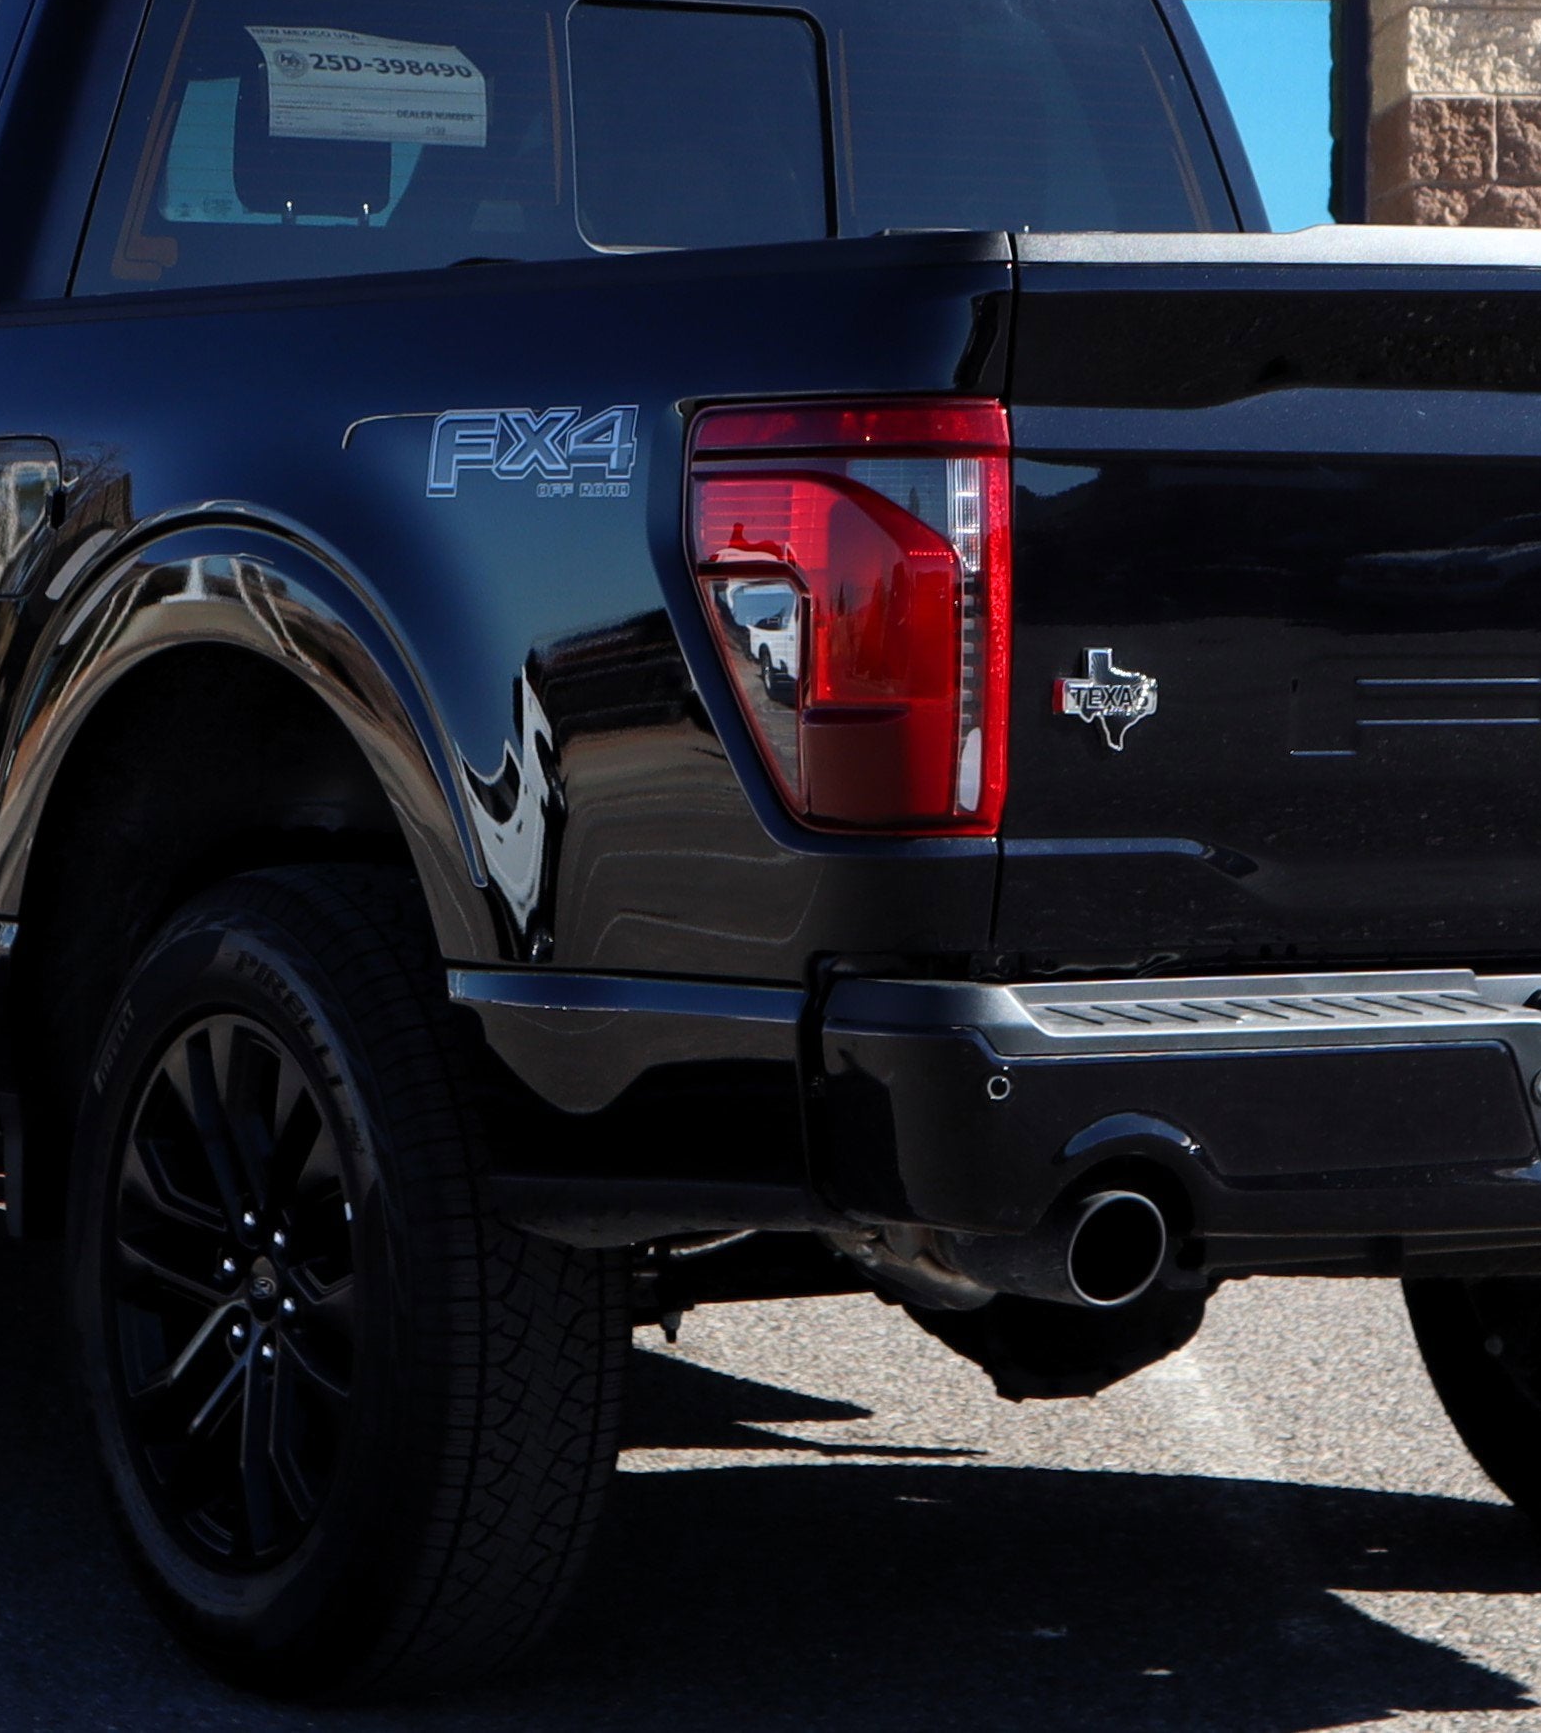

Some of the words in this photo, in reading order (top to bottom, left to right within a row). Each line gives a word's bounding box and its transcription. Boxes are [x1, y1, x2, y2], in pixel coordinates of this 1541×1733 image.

[308, 52, 473, 78] 25D-398490
[396, 109, 433, 120] DEALER
[435, 112, 474, 122] NUMBER
[426, 404, 639, 497] FX4
[536, 482, 575, 497] OFF
[578, 482, 630, 497] ROAD
[233, 950, 345, 1089] PIRELLI
